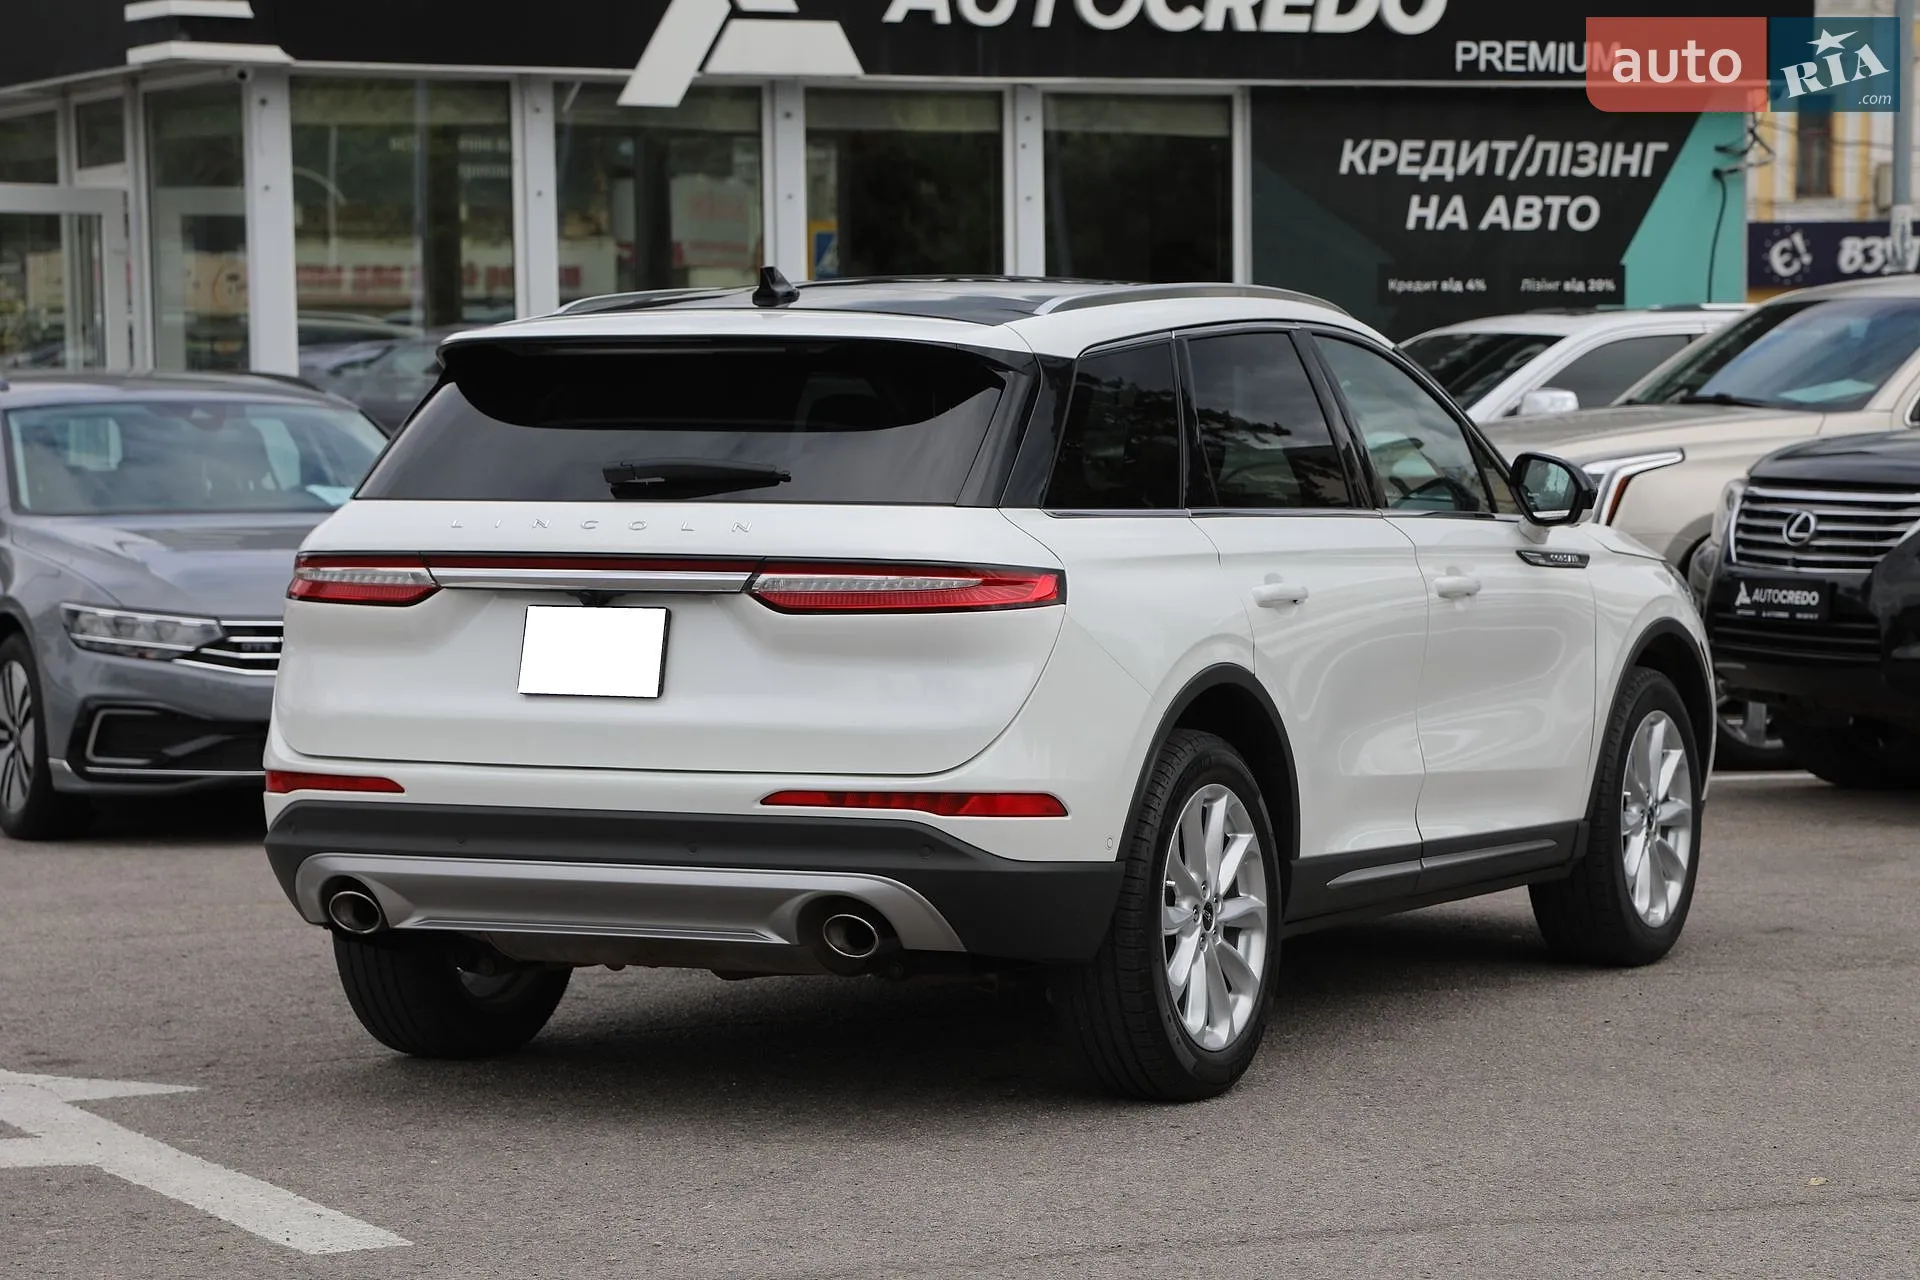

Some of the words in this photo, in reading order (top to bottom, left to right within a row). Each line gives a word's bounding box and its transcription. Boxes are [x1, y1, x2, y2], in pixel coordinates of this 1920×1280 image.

[1455, 40, 1621, 74] PREMIUM
[1339, 135, 1669, 182] КРЕДИТ/ЛІЗІНГ
[1406, 195, 1468, 231] НА
[1479, 195, 1600, 232] АВТО
[1387, 278, 1438, 294] Кредит
[450, 518, 753, 533] LINCOLN
[1752, 588, 1820, 606] AUTOCREDO
